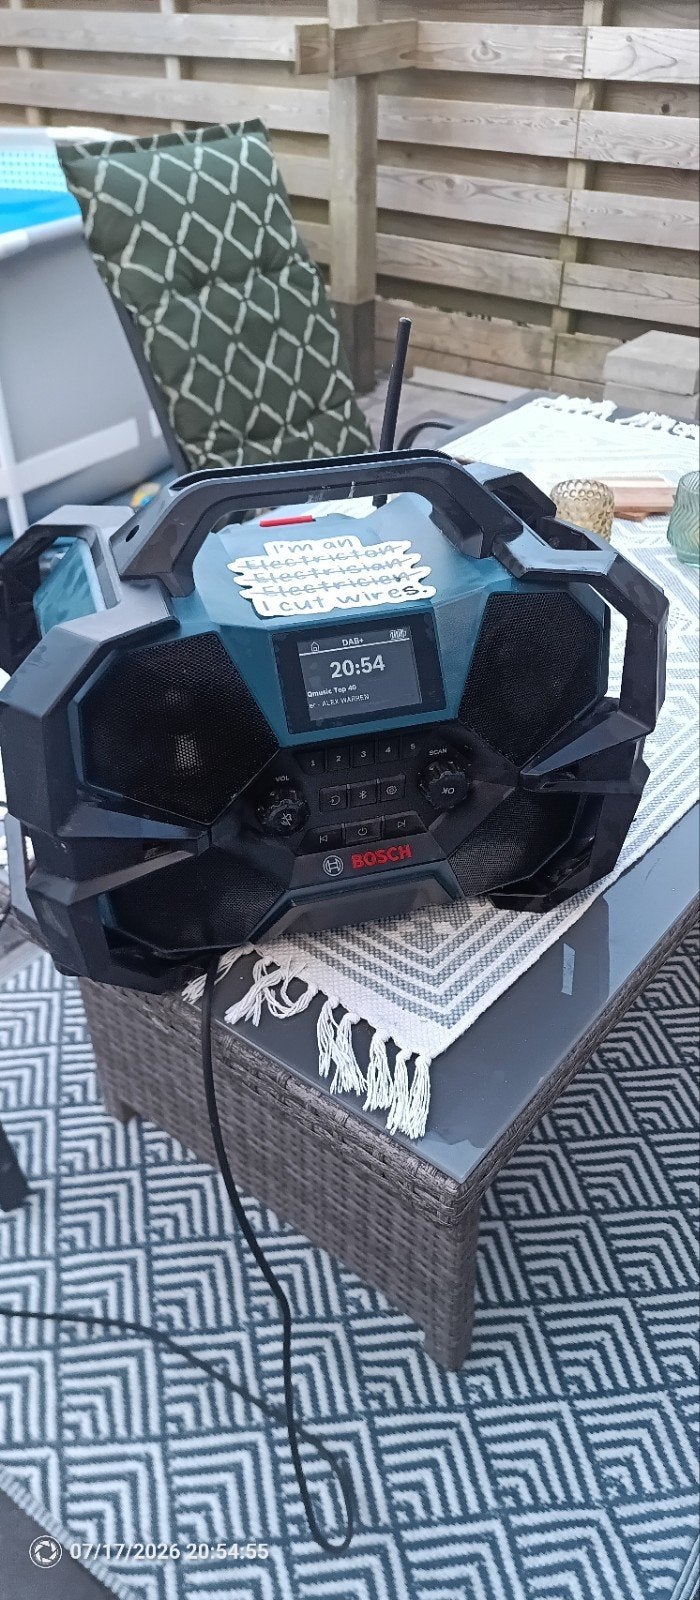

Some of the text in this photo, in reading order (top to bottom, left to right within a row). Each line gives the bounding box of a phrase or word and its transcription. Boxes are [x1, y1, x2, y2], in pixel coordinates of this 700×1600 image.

[273, 538, 353, 554] I'm an
[279, 597, 324, 612] cut
[341, 637, 364, 646] DAB+
[329, 654, 386, 679] 20:54
[307, 689, 333, 698] Qmusic
[333, 686, 347, 694] Top
[360, 750, 367, 758] 3
[428, 748, 448, 756] SCAN
[275, 775, 290, 783] VOL
[351, 845, 412, 869] BOSCH
